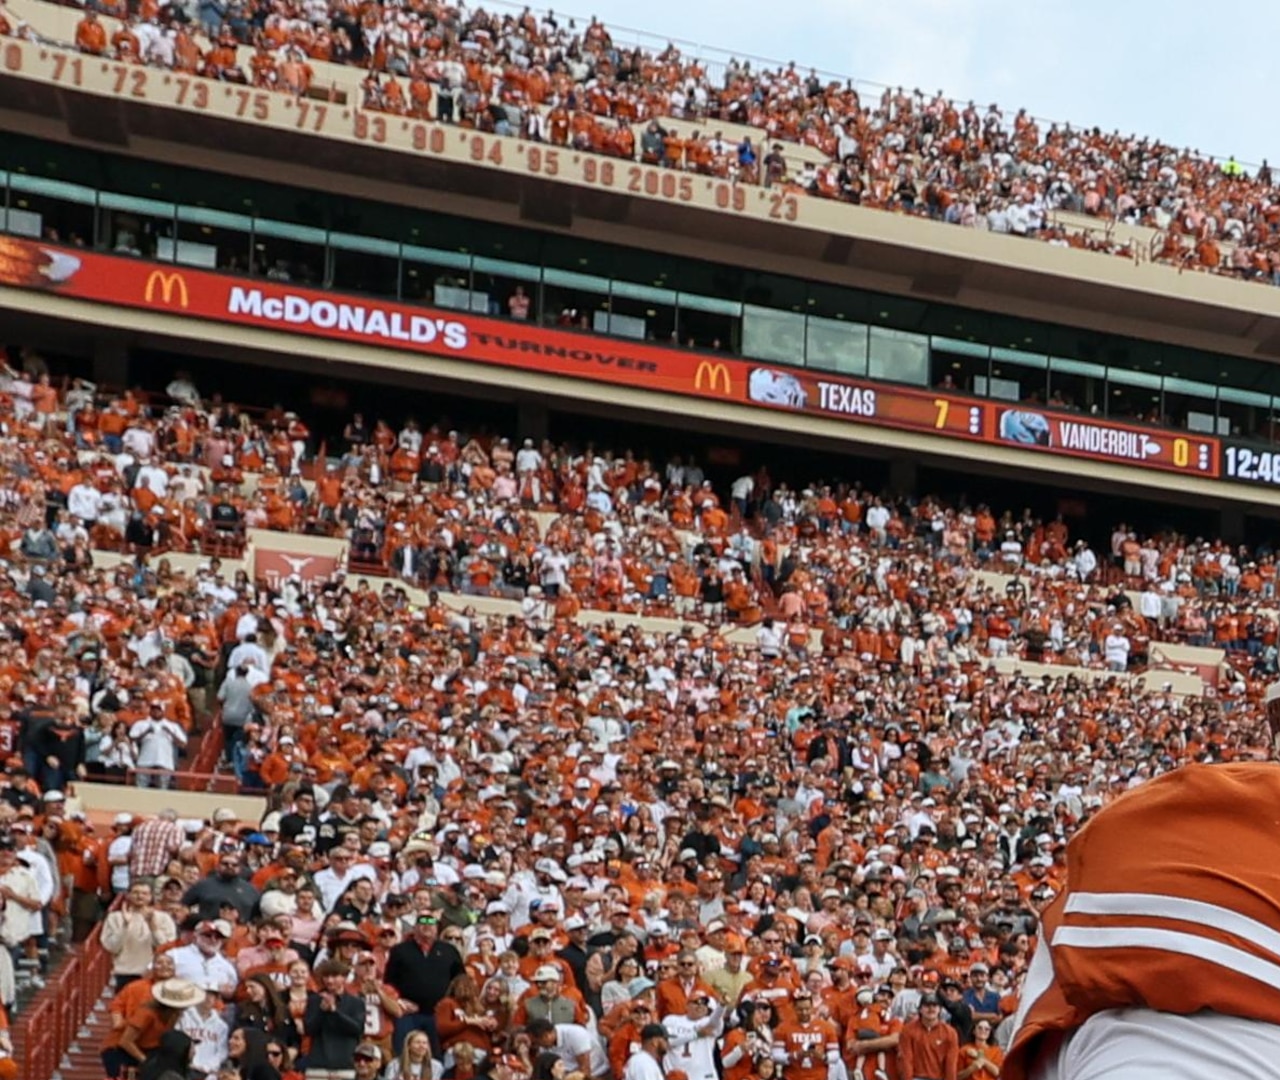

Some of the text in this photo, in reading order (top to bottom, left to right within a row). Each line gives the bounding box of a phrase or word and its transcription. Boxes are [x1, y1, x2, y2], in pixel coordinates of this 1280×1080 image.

[39, 50, 83, 86] '71
[101, 64, 147, 97] '72
[163, 76, 209, 109] '73
[225, 87, 269, 120] '75
[285, 101, 327, 132] '77
[628, 167, 693, 202] 2005
[760, 191, 798, 221] '23
[228, 286, 467, 349] McDONALD'S
[471, 331, 656, 373] TURNOVER
[817, 381, 949, 429] TEXAS 7
[1059, 420, 1189, 467] VANDERBILT 0
